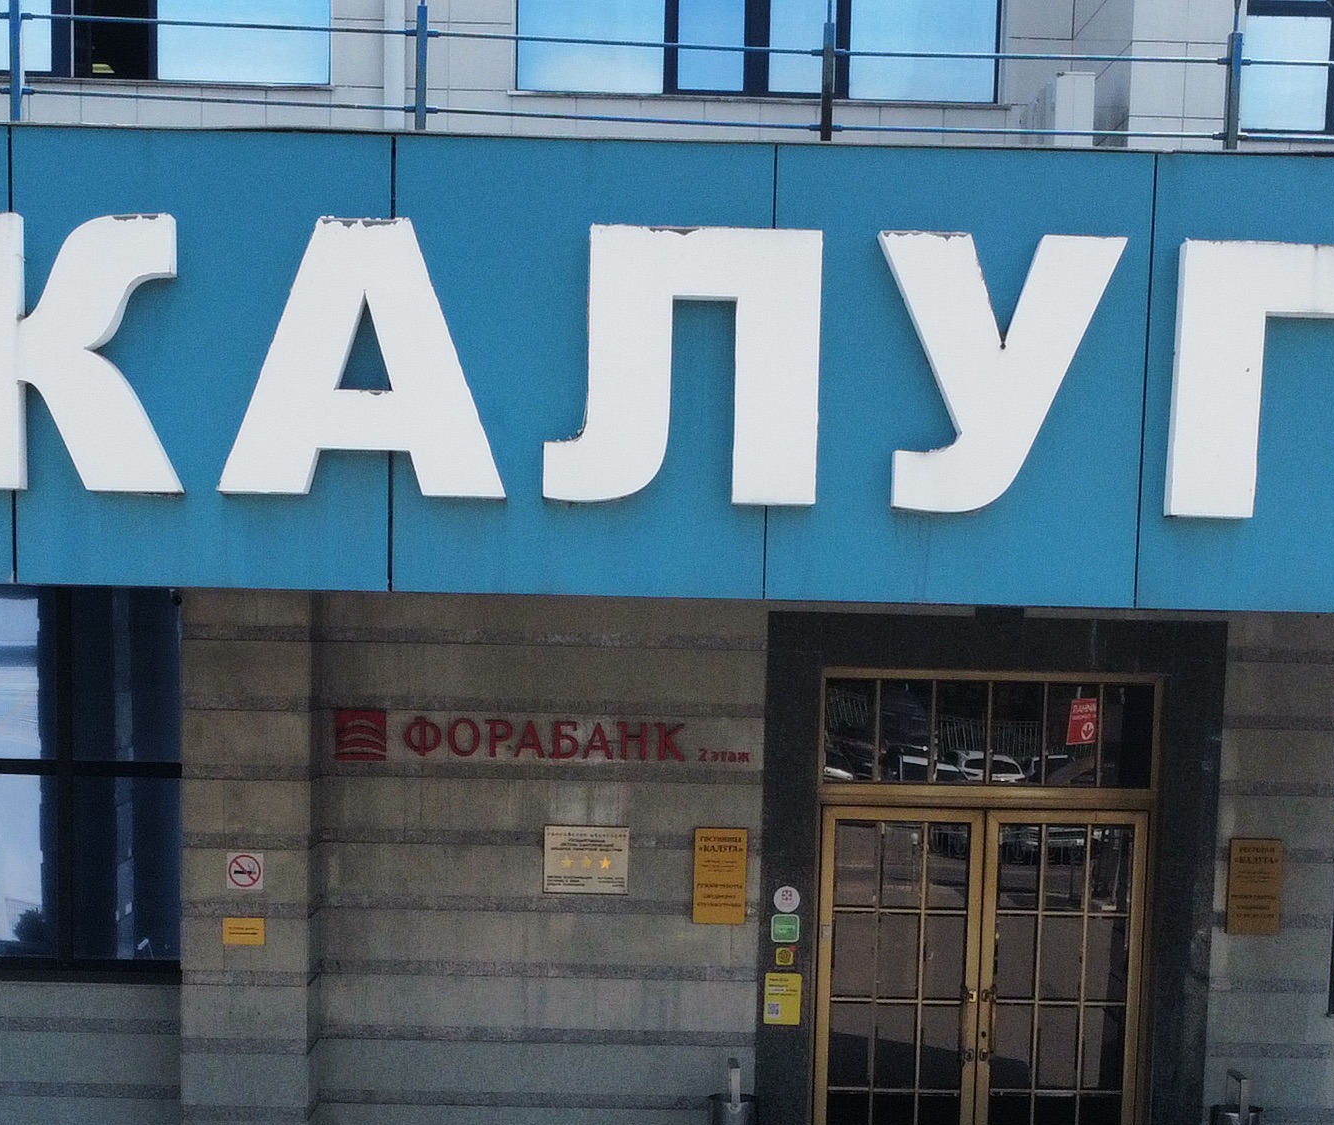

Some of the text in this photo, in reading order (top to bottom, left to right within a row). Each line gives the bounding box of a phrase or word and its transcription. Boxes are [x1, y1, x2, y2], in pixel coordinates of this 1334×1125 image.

[402, 715, 751, 763] ФОРАБАНК 2 этаж
